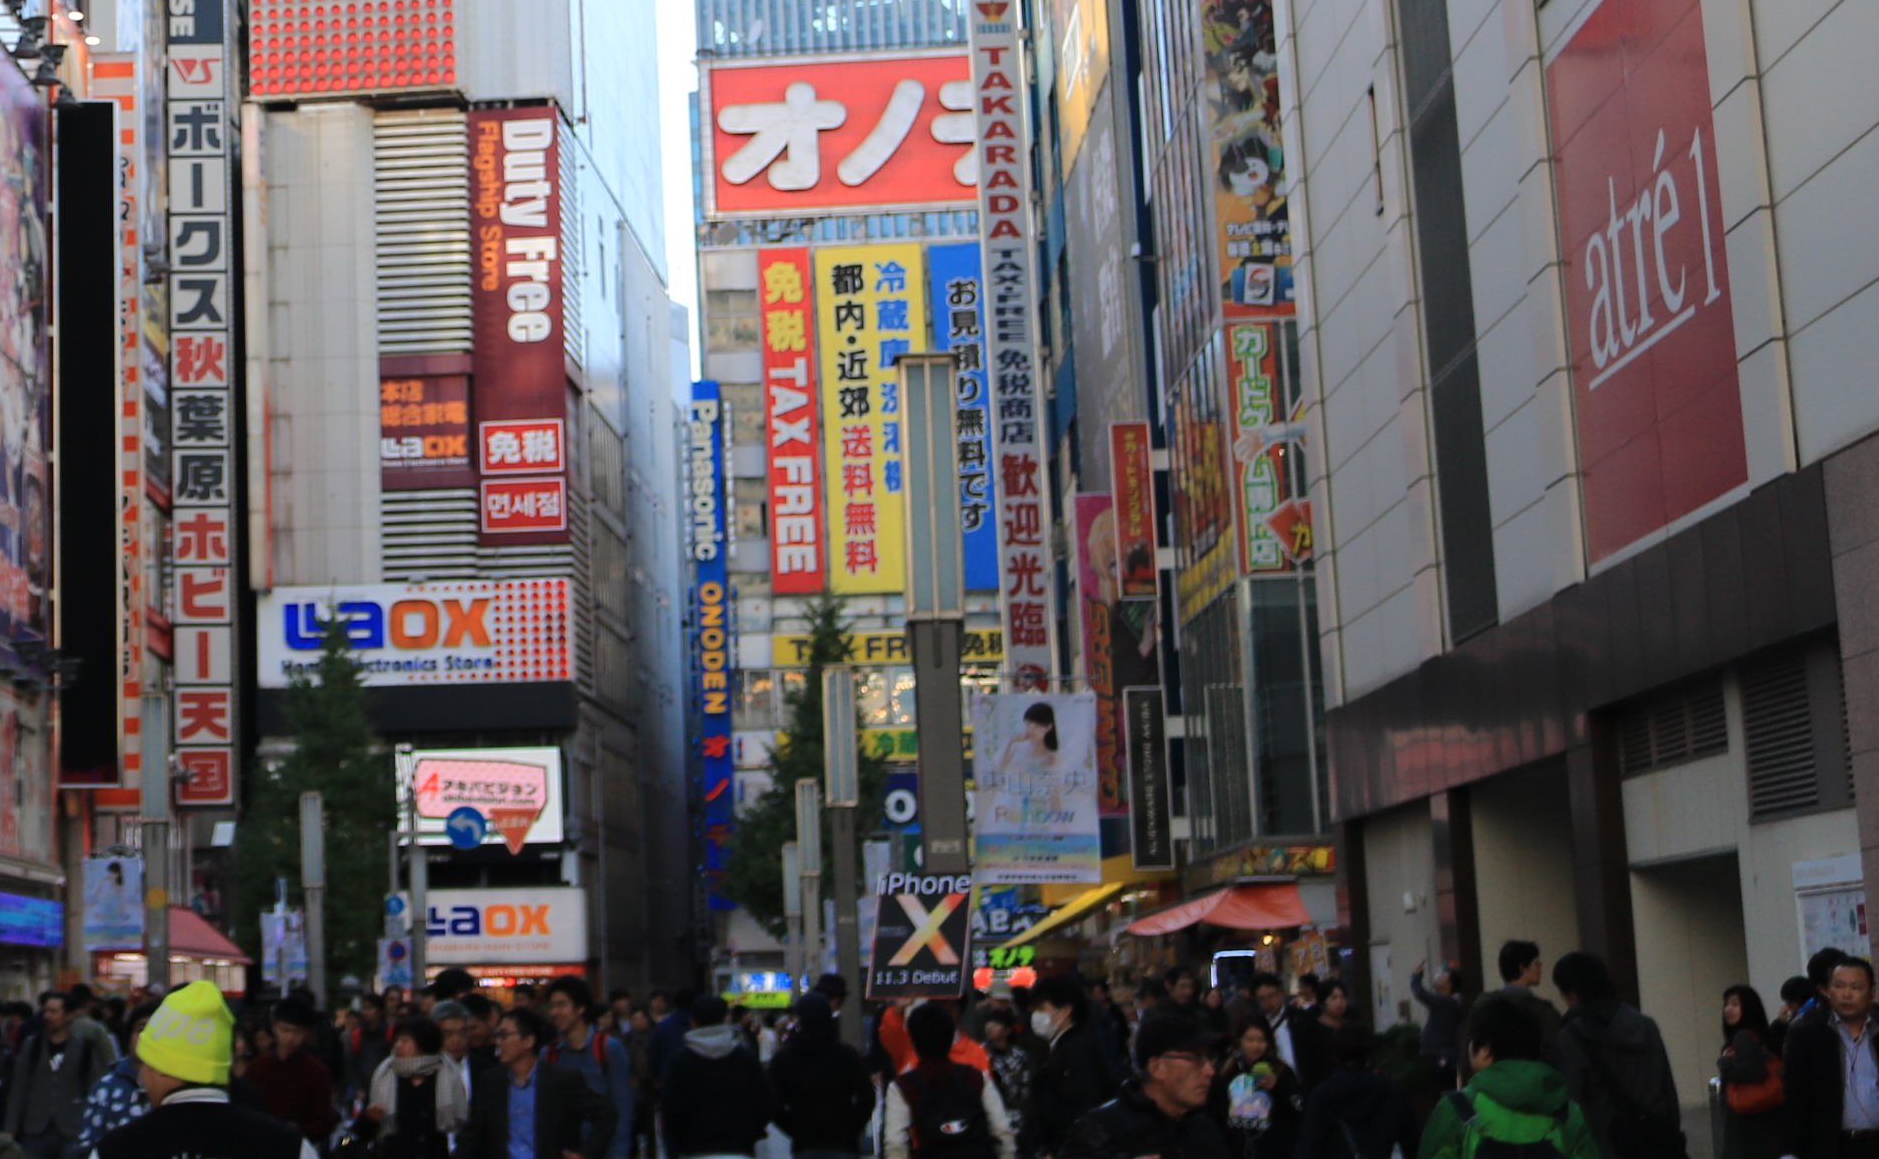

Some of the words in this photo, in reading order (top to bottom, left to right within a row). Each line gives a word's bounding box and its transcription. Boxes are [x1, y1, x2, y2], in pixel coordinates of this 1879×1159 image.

[473, 119, 503, 219] Flagship
[498, 117, 554, 228] Duty
[978, 45, 1021, 240] TAKARADA
[479, 224, 503, 292] Store
[503, 236, 557, 343] Free
[1583, 126, 1686, 372] atré
[763, 260, 807, 353] 免税
[769, 358, 811, 446] TAX
[995, 349, 1034, 444] 免税商店
[486, 429, 558, 465] 免税
[691, 398, 724, 562] Panasonic
[1232, 325, 1282, 570] カードゲム専門店
[487, 489, 561, 521] 면세점
[773, 456, 818, 576] FREE
[282, 657, 322, 677] Hom
[445, 655, 495, 672] Store
[699, 581, 729, 715] ONODEN
[442, 779, 538, 796] アキバビジョン
[878, 872, 972, 896] iPhone
[886, 892, 970, 967] X
[874, 969, 909, 986] 11.3
[911, 969, 960, 986] Debut
